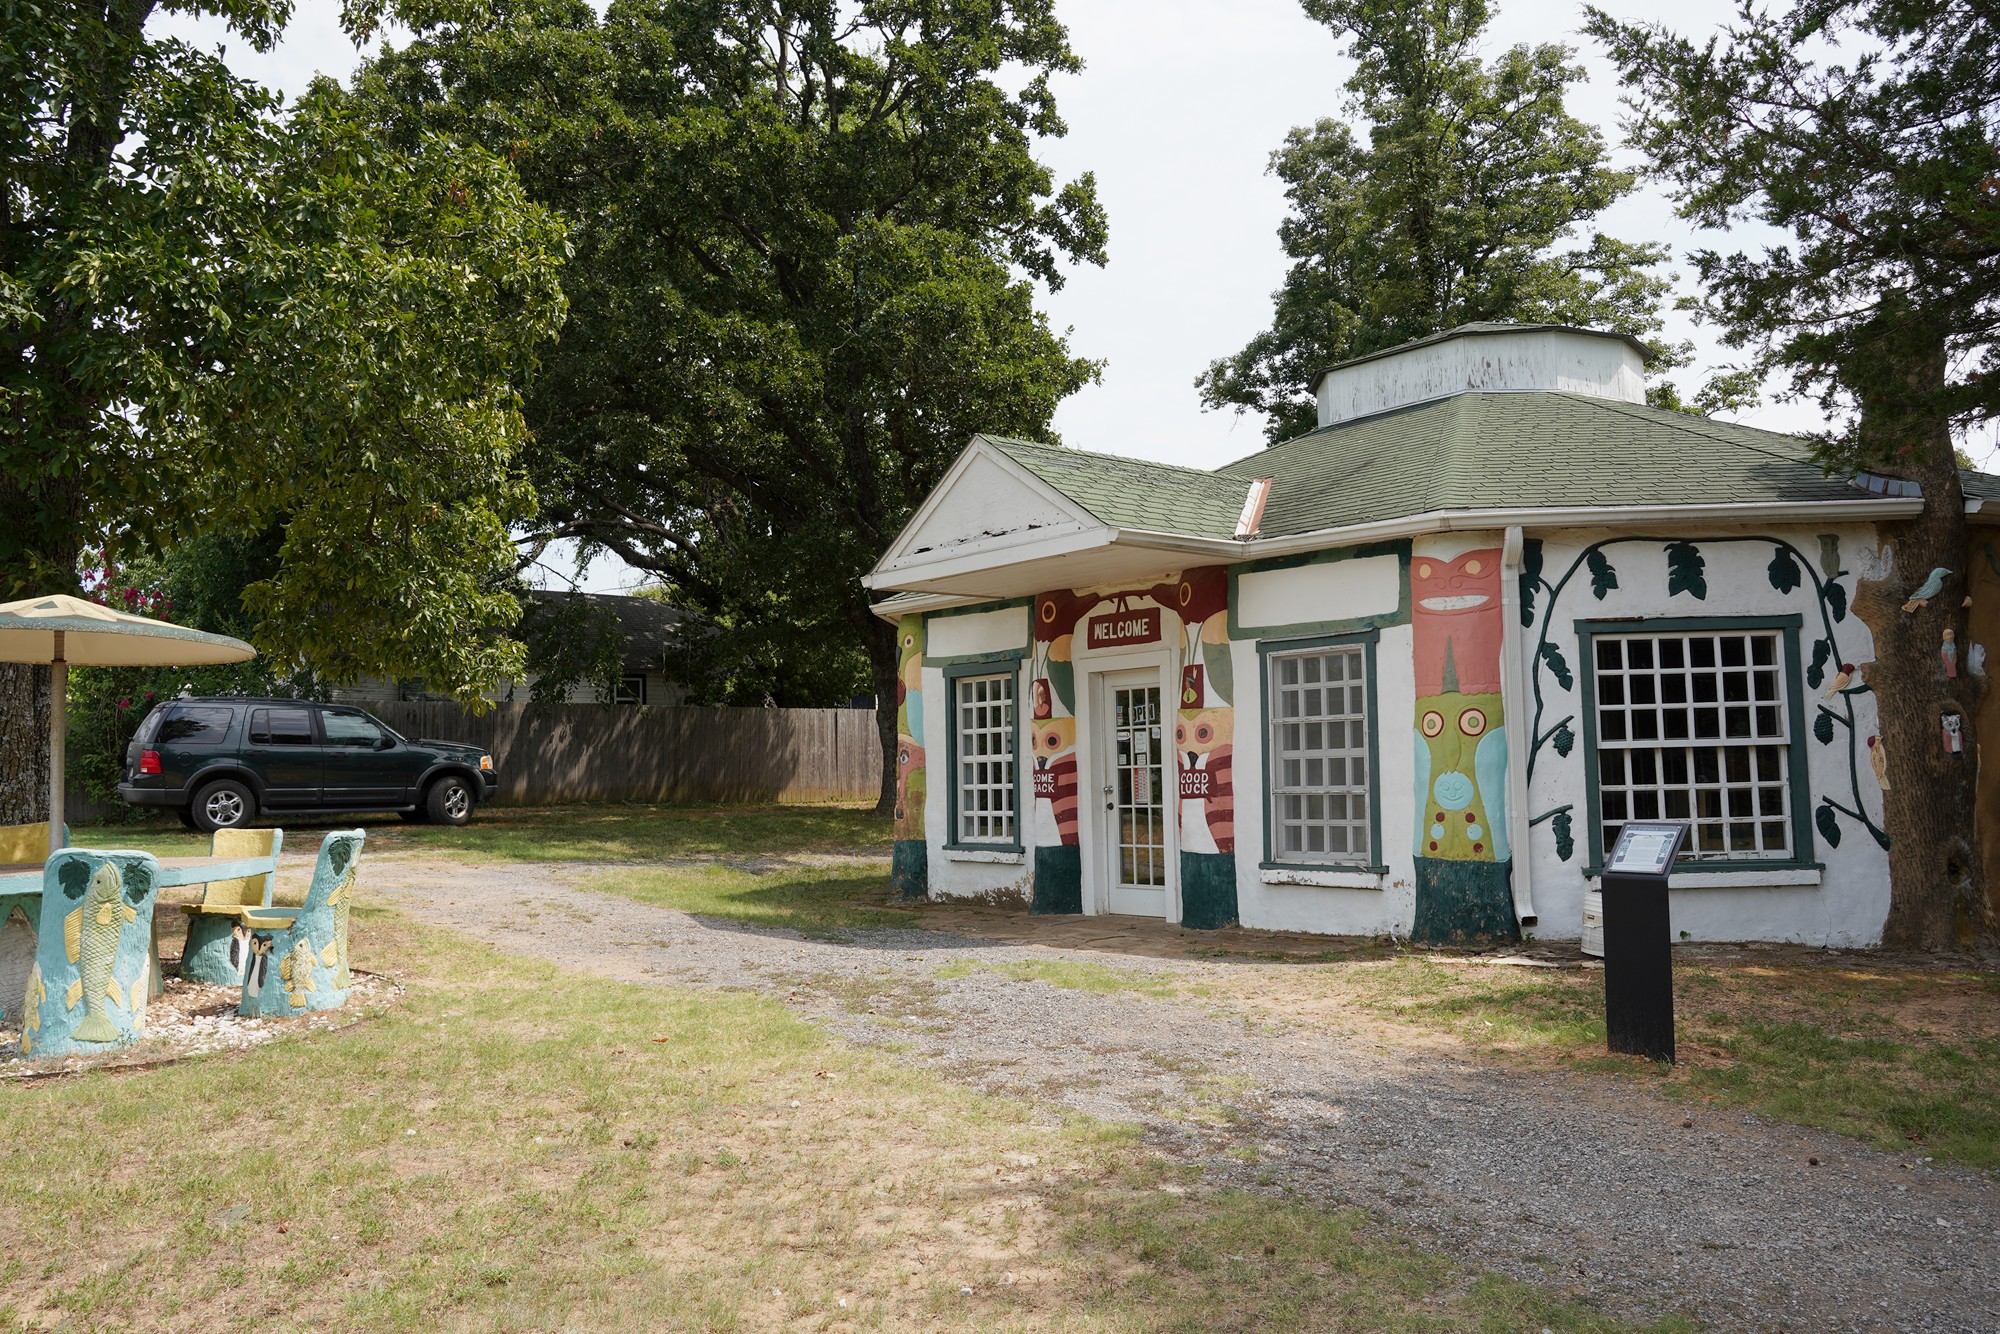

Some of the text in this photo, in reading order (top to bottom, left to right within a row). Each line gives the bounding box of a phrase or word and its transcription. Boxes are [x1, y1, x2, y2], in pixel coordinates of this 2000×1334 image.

[1094, 618, 1150, 640] WELCOME
[1180, 772, 1209, 784] GOOD
[1180, 783, 1209, 795] LUCK
